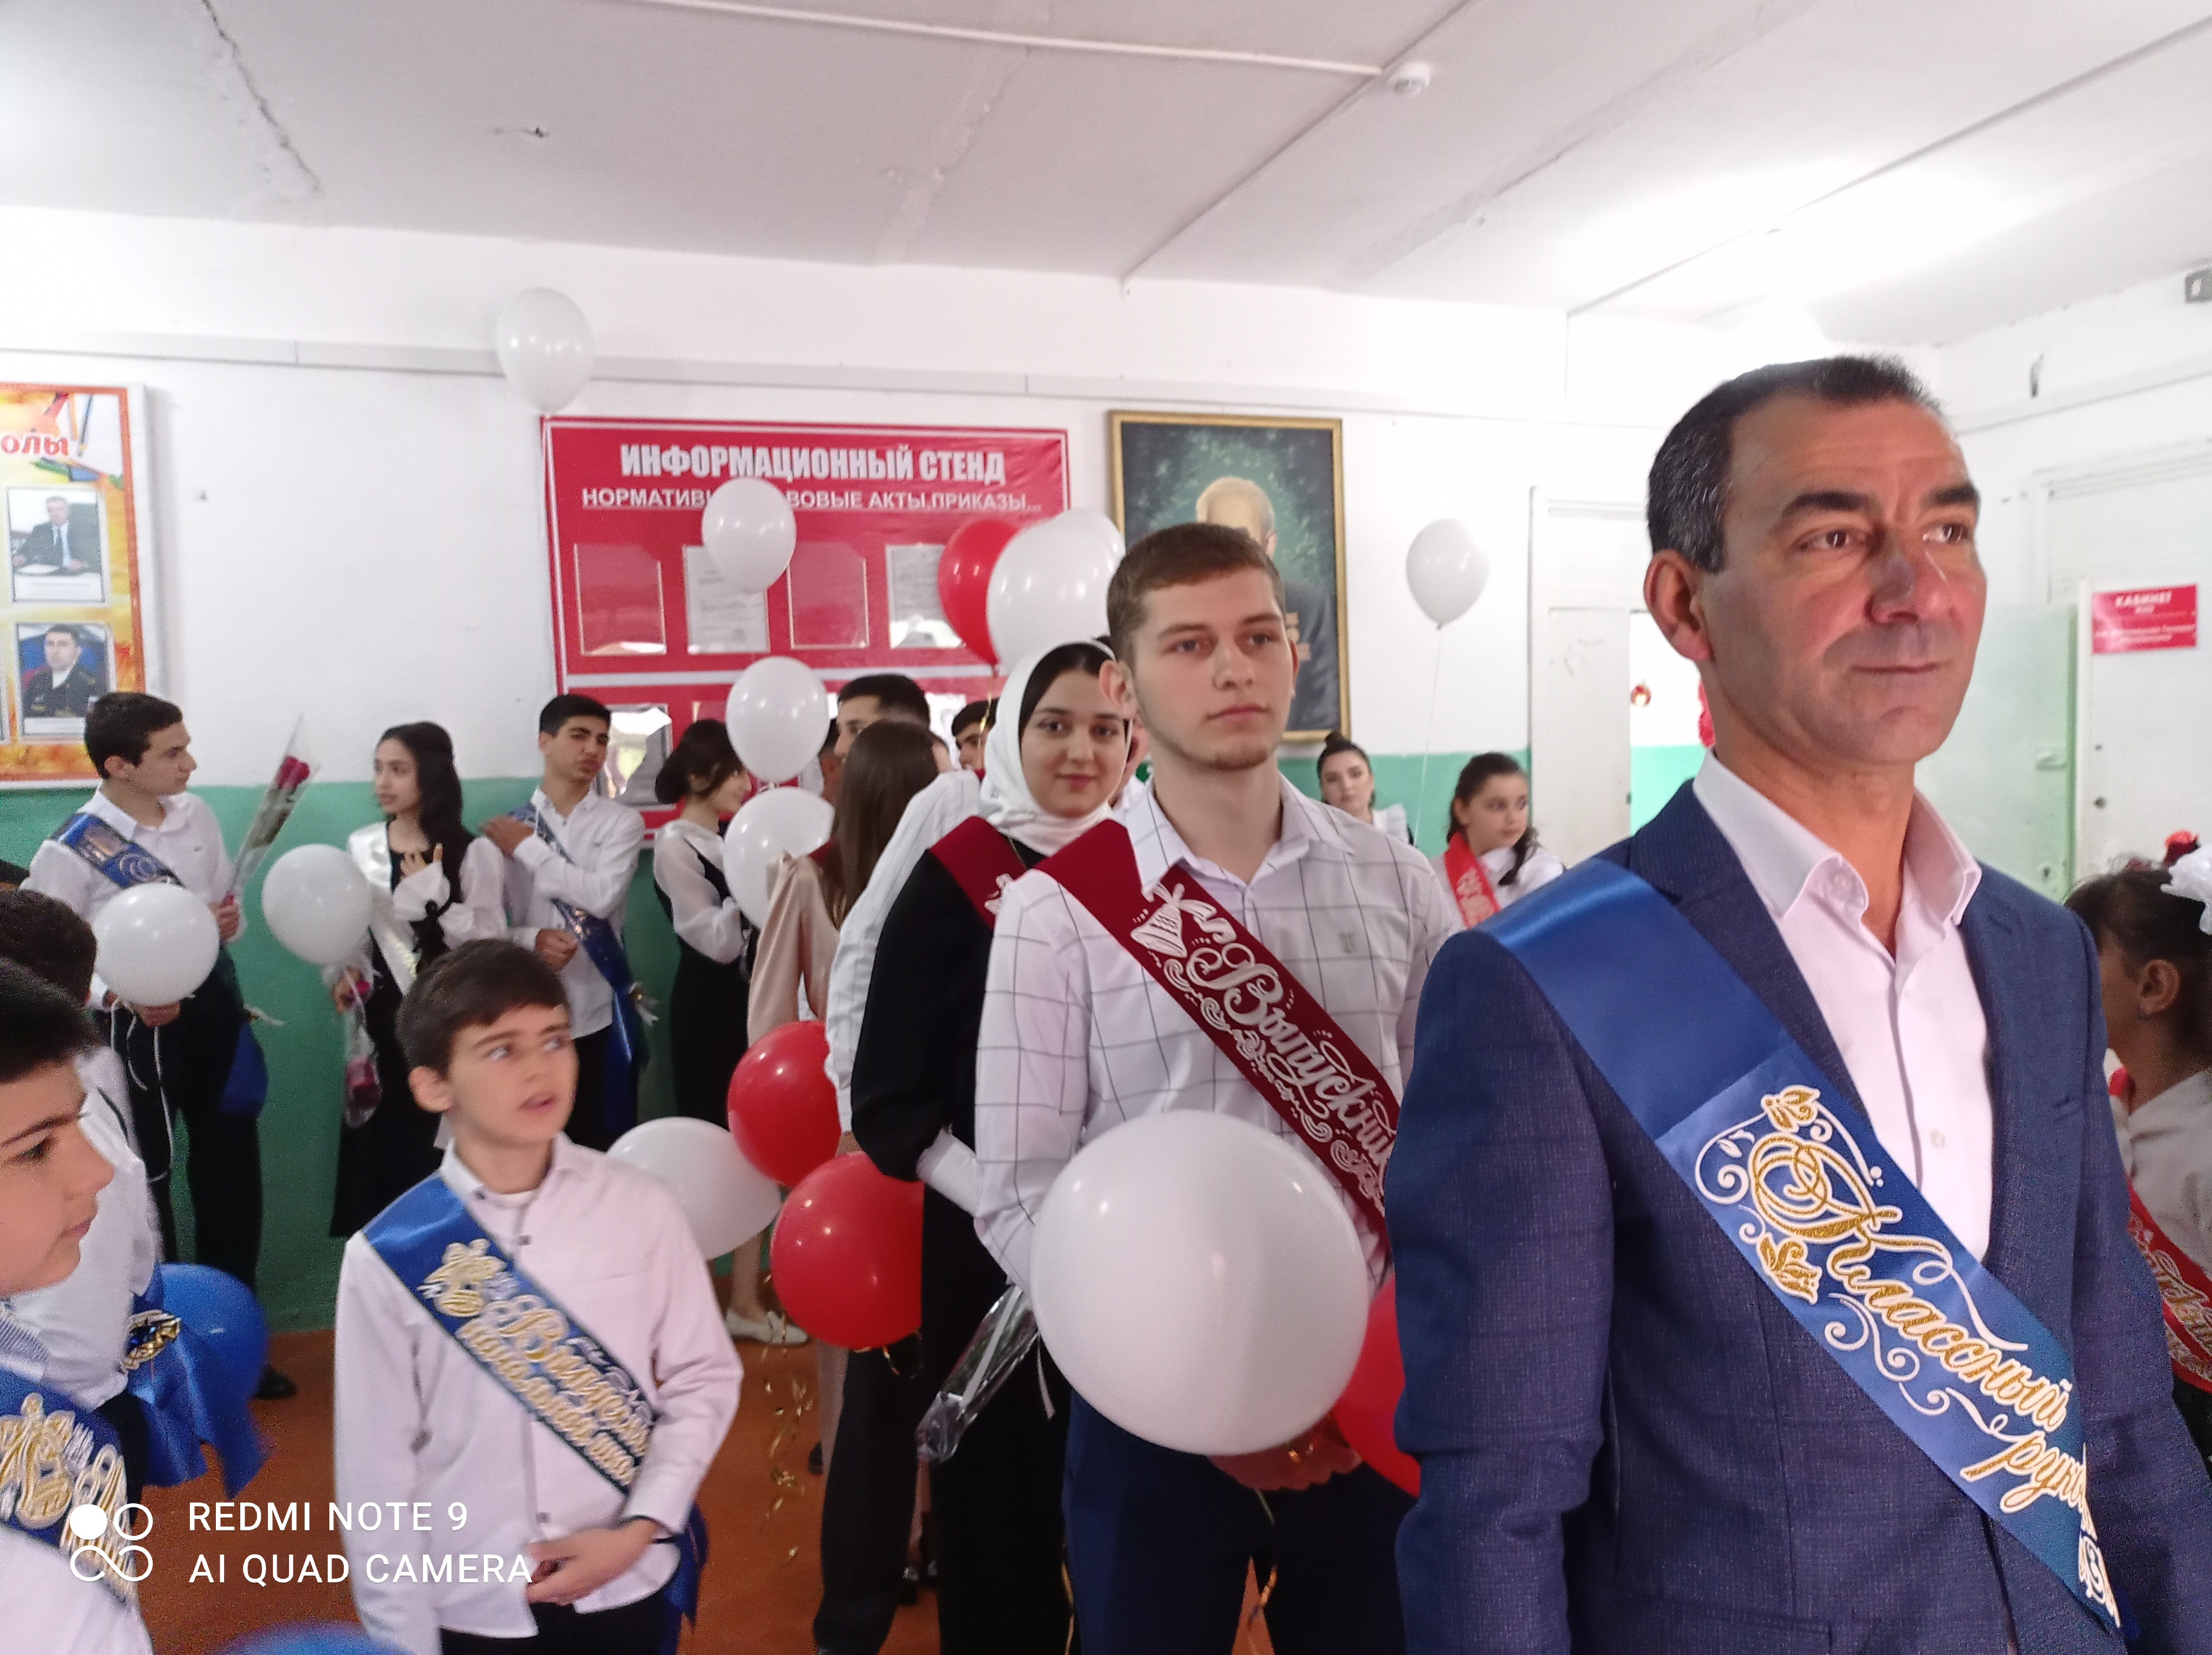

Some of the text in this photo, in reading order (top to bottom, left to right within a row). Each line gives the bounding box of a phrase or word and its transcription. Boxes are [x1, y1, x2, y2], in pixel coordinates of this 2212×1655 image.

[1, 435, 69, 456] олы
[621, 443, 1006, 485] ИНФОРМАЦИОННЫЙ СТЕНД
[785, 490, 864, 509] ВОВЫЕ
